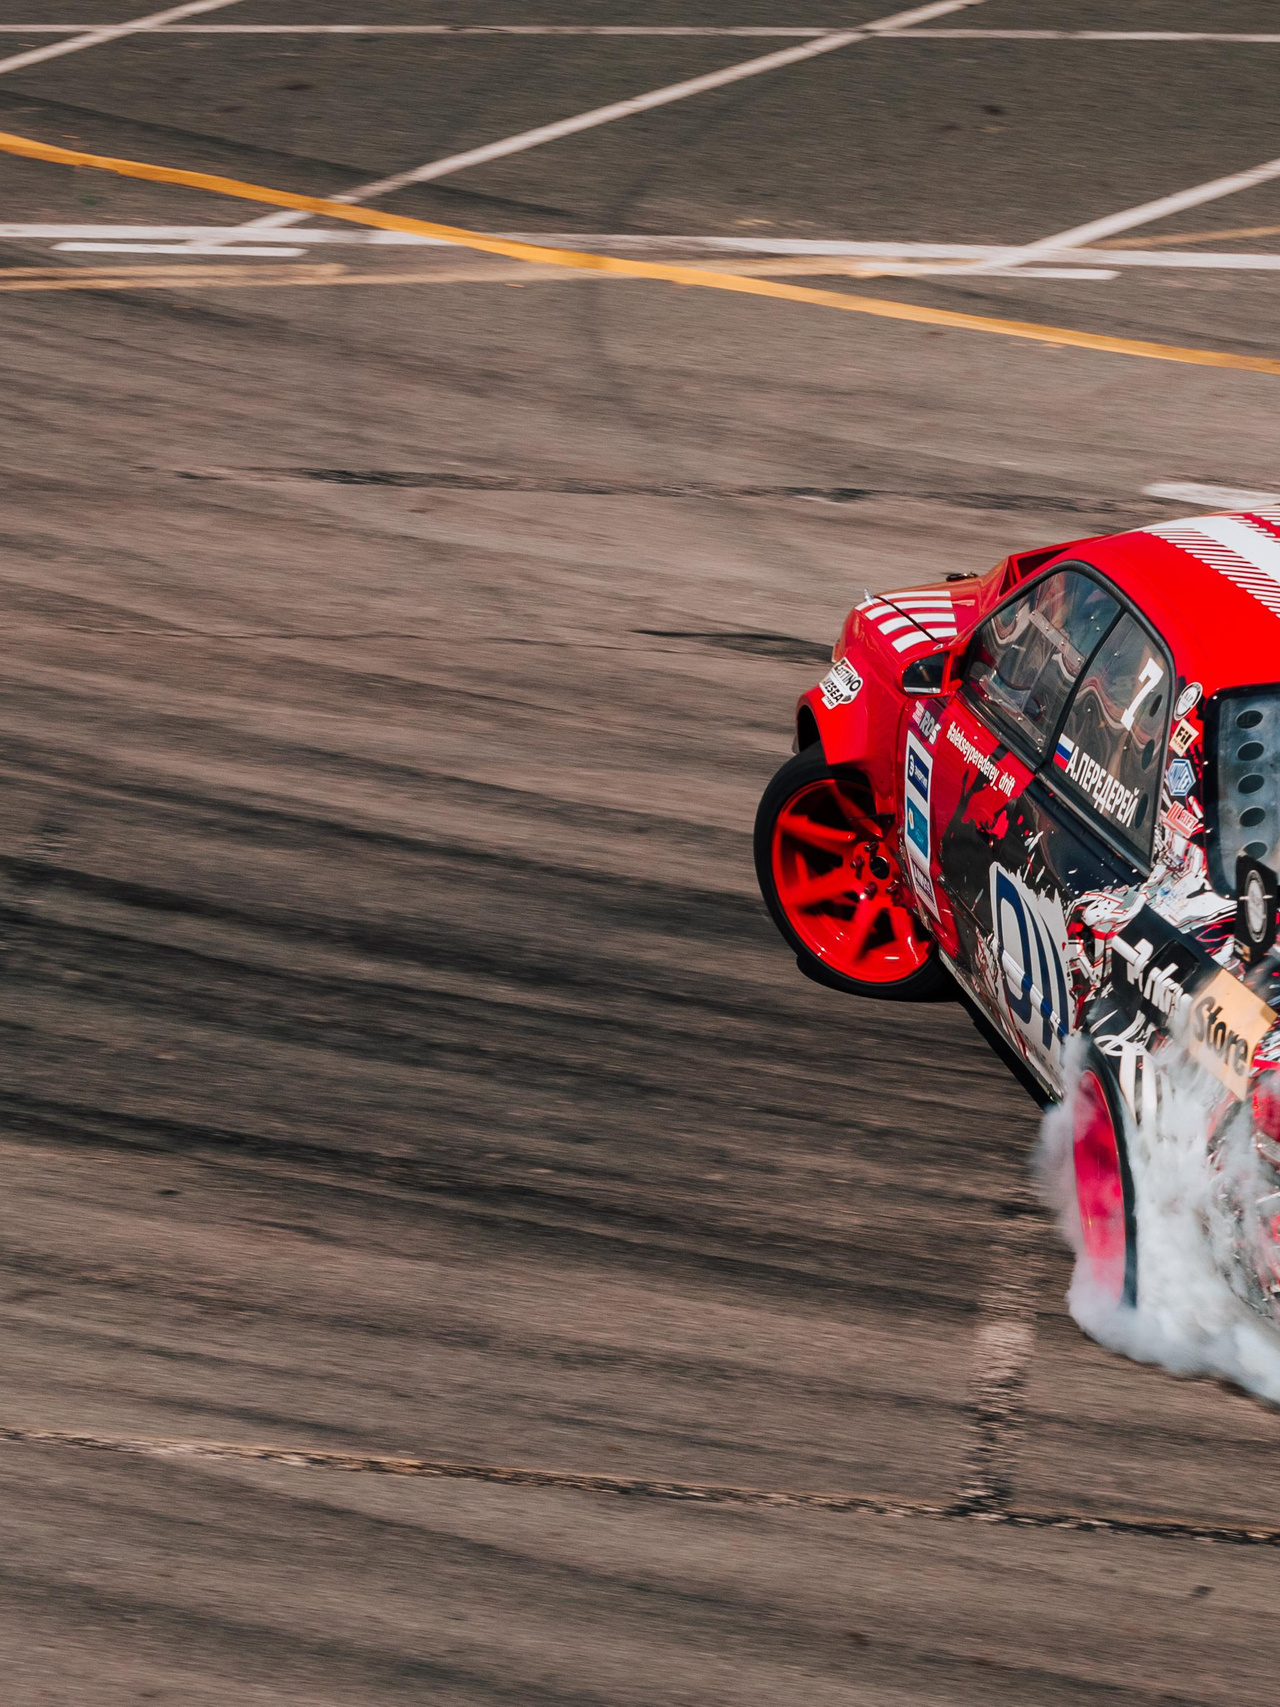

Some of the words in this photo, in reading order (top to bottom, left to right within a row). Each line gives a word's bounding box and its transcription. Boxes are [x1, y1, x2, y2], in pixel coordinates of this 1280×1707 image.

[1120, 657, 1164, 731] 7
[1175, 726, 1192, 746] Fil
[1065, 745, 1140, 828] А.ПЕРЕДЕРЕЙ
[1194, 995, 1250, 1077] Store
